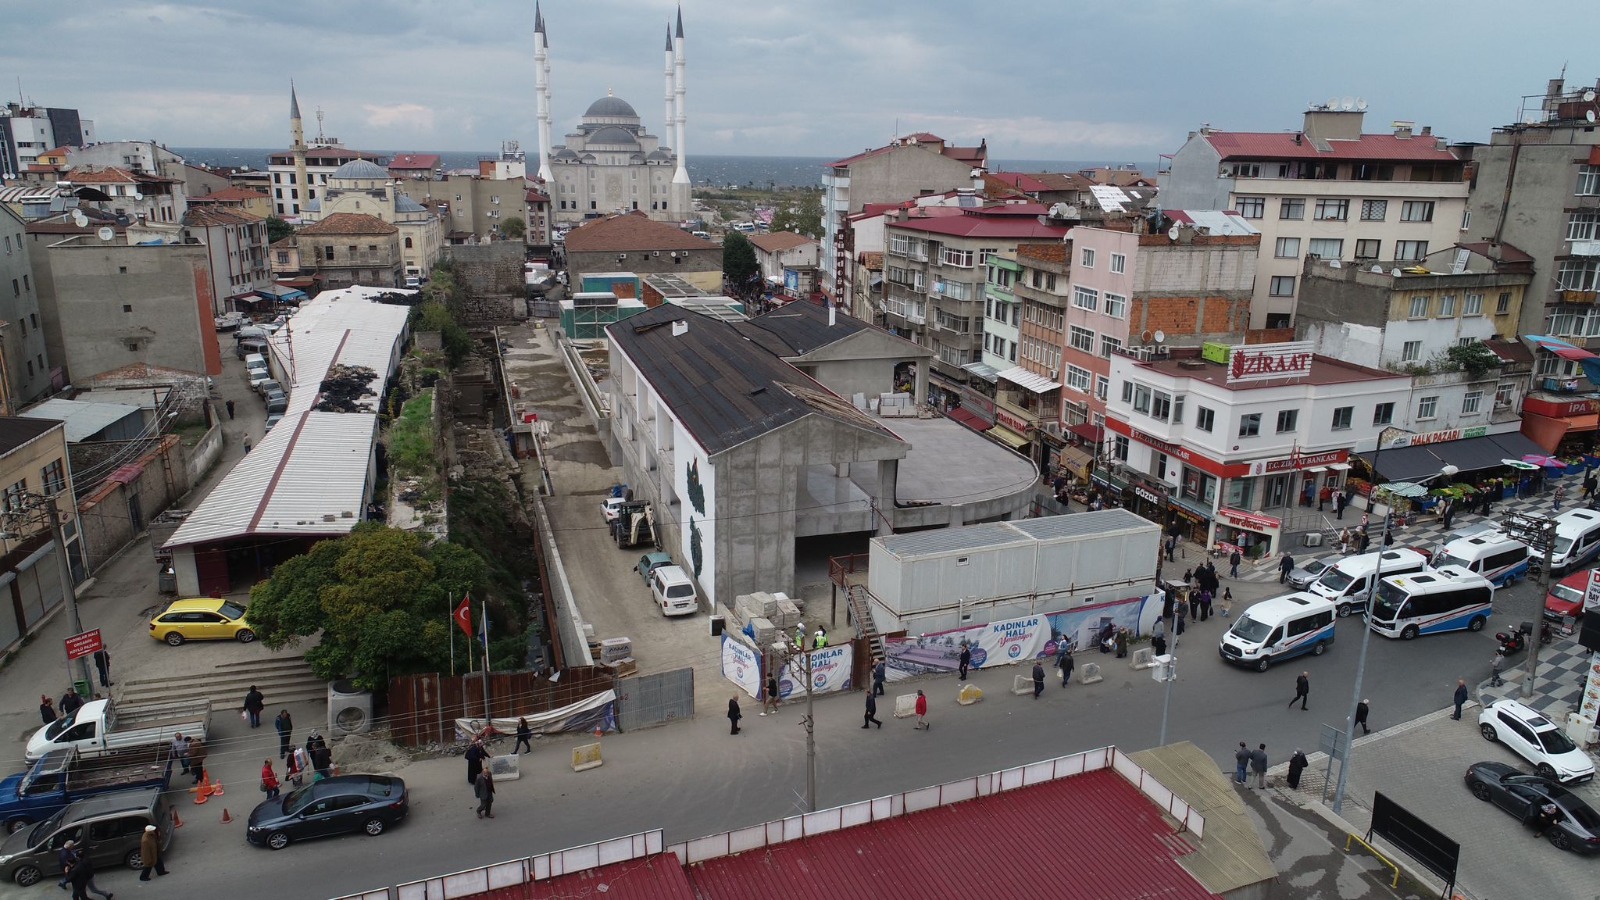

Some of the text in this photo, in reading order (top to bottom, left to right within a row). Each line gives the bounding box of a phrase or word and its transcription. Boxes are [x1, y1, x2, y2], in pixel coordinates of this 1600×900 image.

[1243, 352, 1309, 374] ZİRAAT
[1410, 433, 1431, 445] HALK
[1432, 430, 1460, 442] PAZARI
[1306, 454, 1337, 464] BANKASI
[993, 618, 1039, 633] KADINLAR
[1006, 628, 1026, 637] HALİ
[801, 648, 843, 664] KDINLAR
